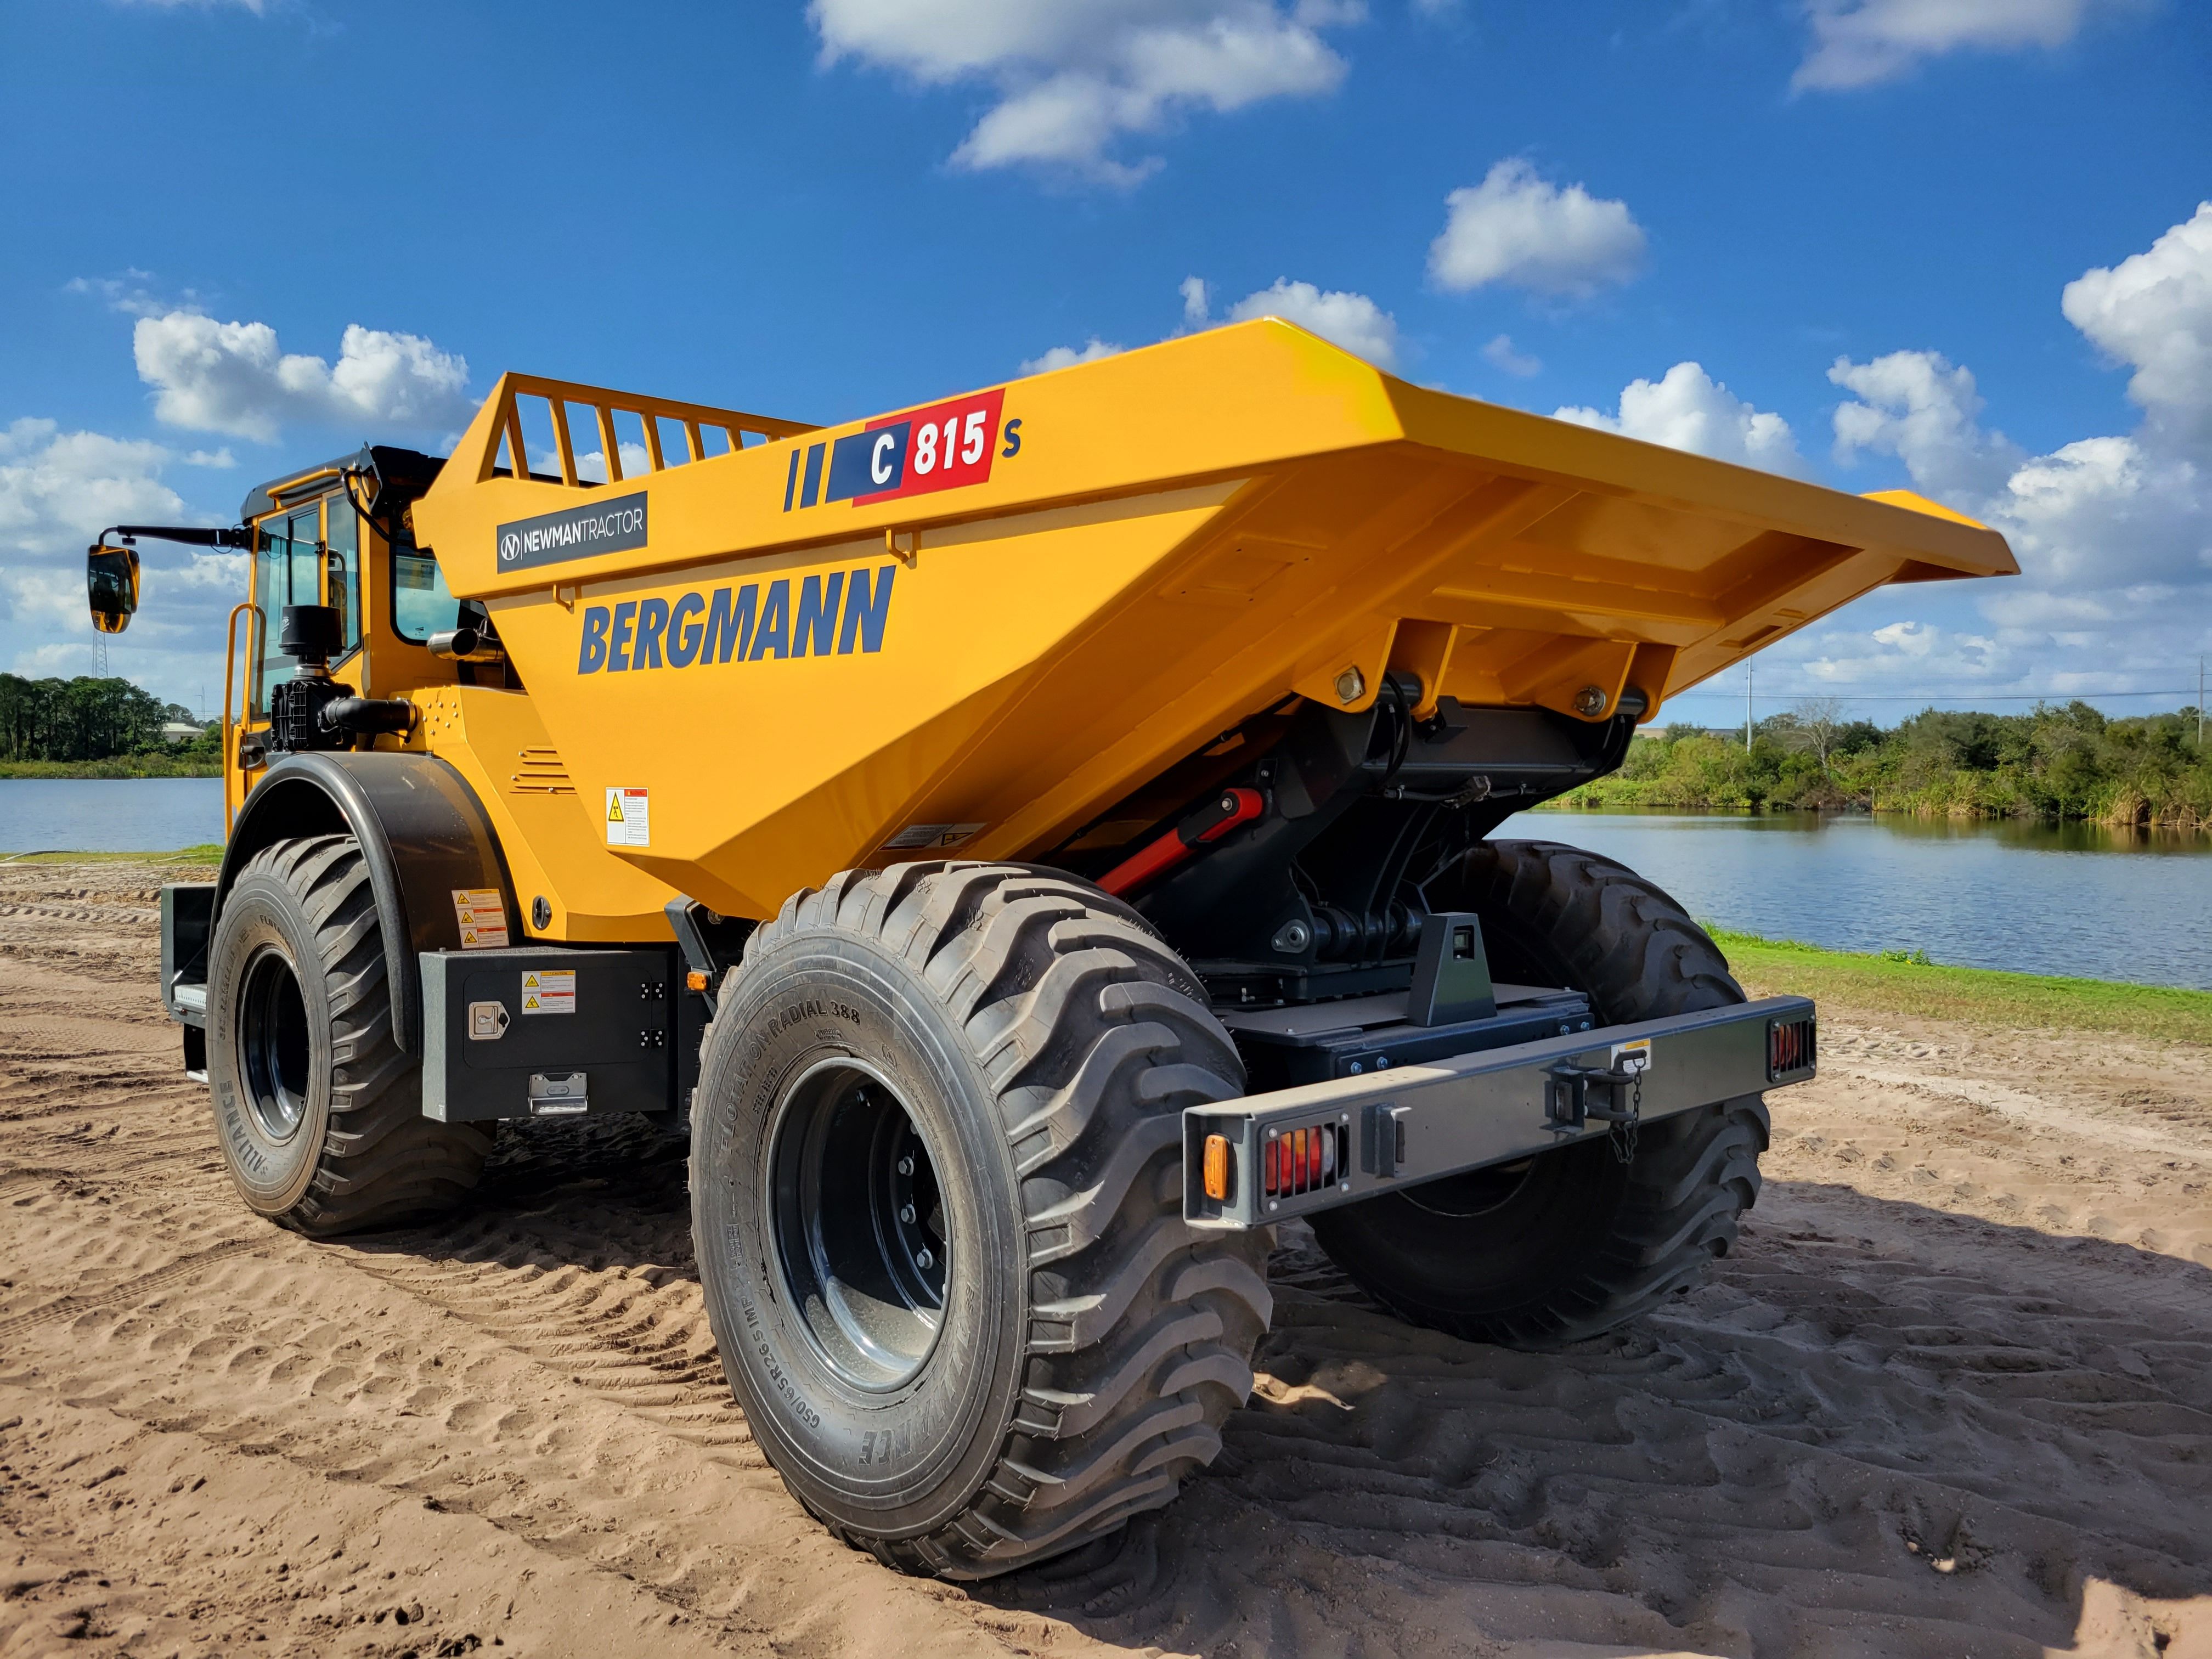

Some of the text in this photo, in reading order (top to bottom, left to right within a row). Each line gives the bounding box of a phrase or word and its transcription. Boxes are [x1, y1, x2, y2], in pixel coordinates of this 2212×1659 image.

[871, 433, 894, 484] C
[914, 410, 986, 475] 815
[579, 566, 896, 673] BERGMANN
[219, 1080, 268, 1172] ALLIANCE
[720, 998, 861, 1155] FLOTATION RADIAL 388
[752, 1329, 821, 1430] 650/65R26.5
